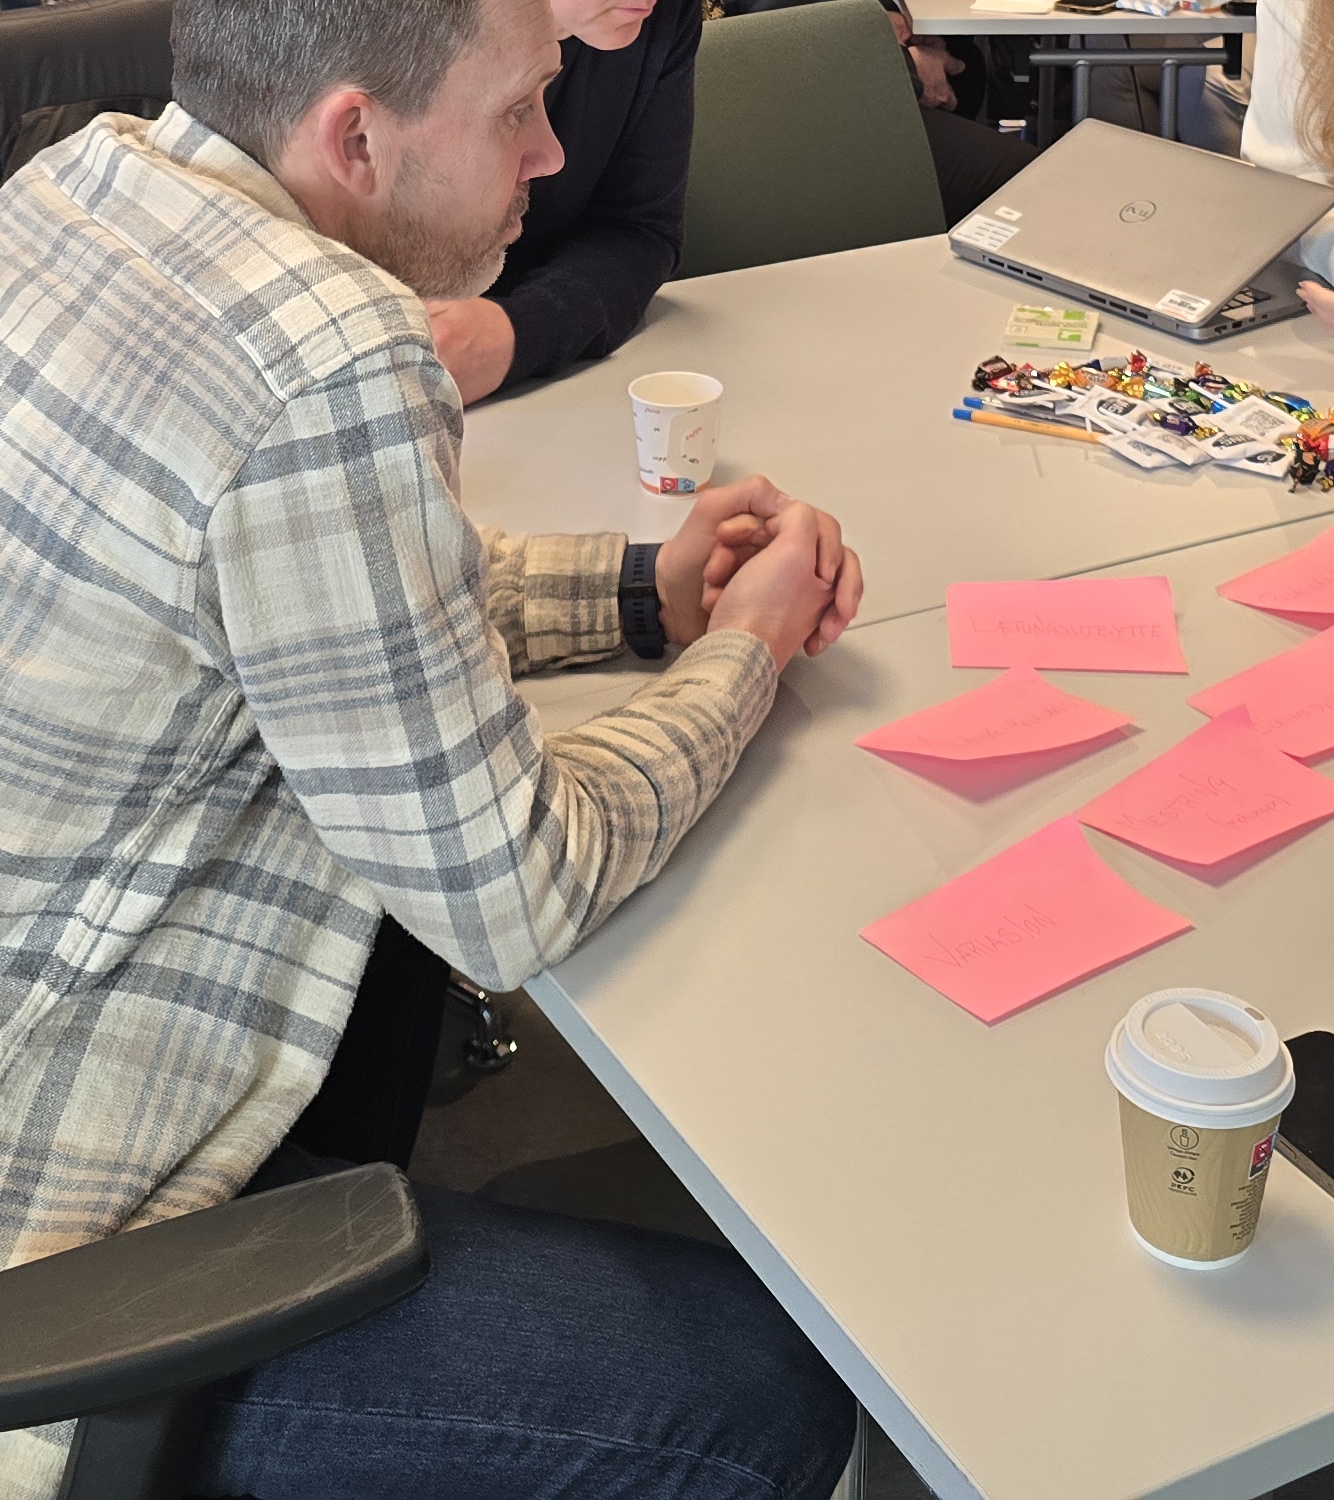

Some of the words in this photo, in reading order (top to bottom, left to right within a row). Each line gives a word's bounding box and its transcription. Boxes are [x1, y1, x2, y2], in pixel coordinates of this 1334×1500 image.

[970, 614, 1163, 639] LÆRINGSUTBYTTE
[1114, 772, 1238, 830] MESTRING
[921, 902, 1058, 968] VARIASJON
